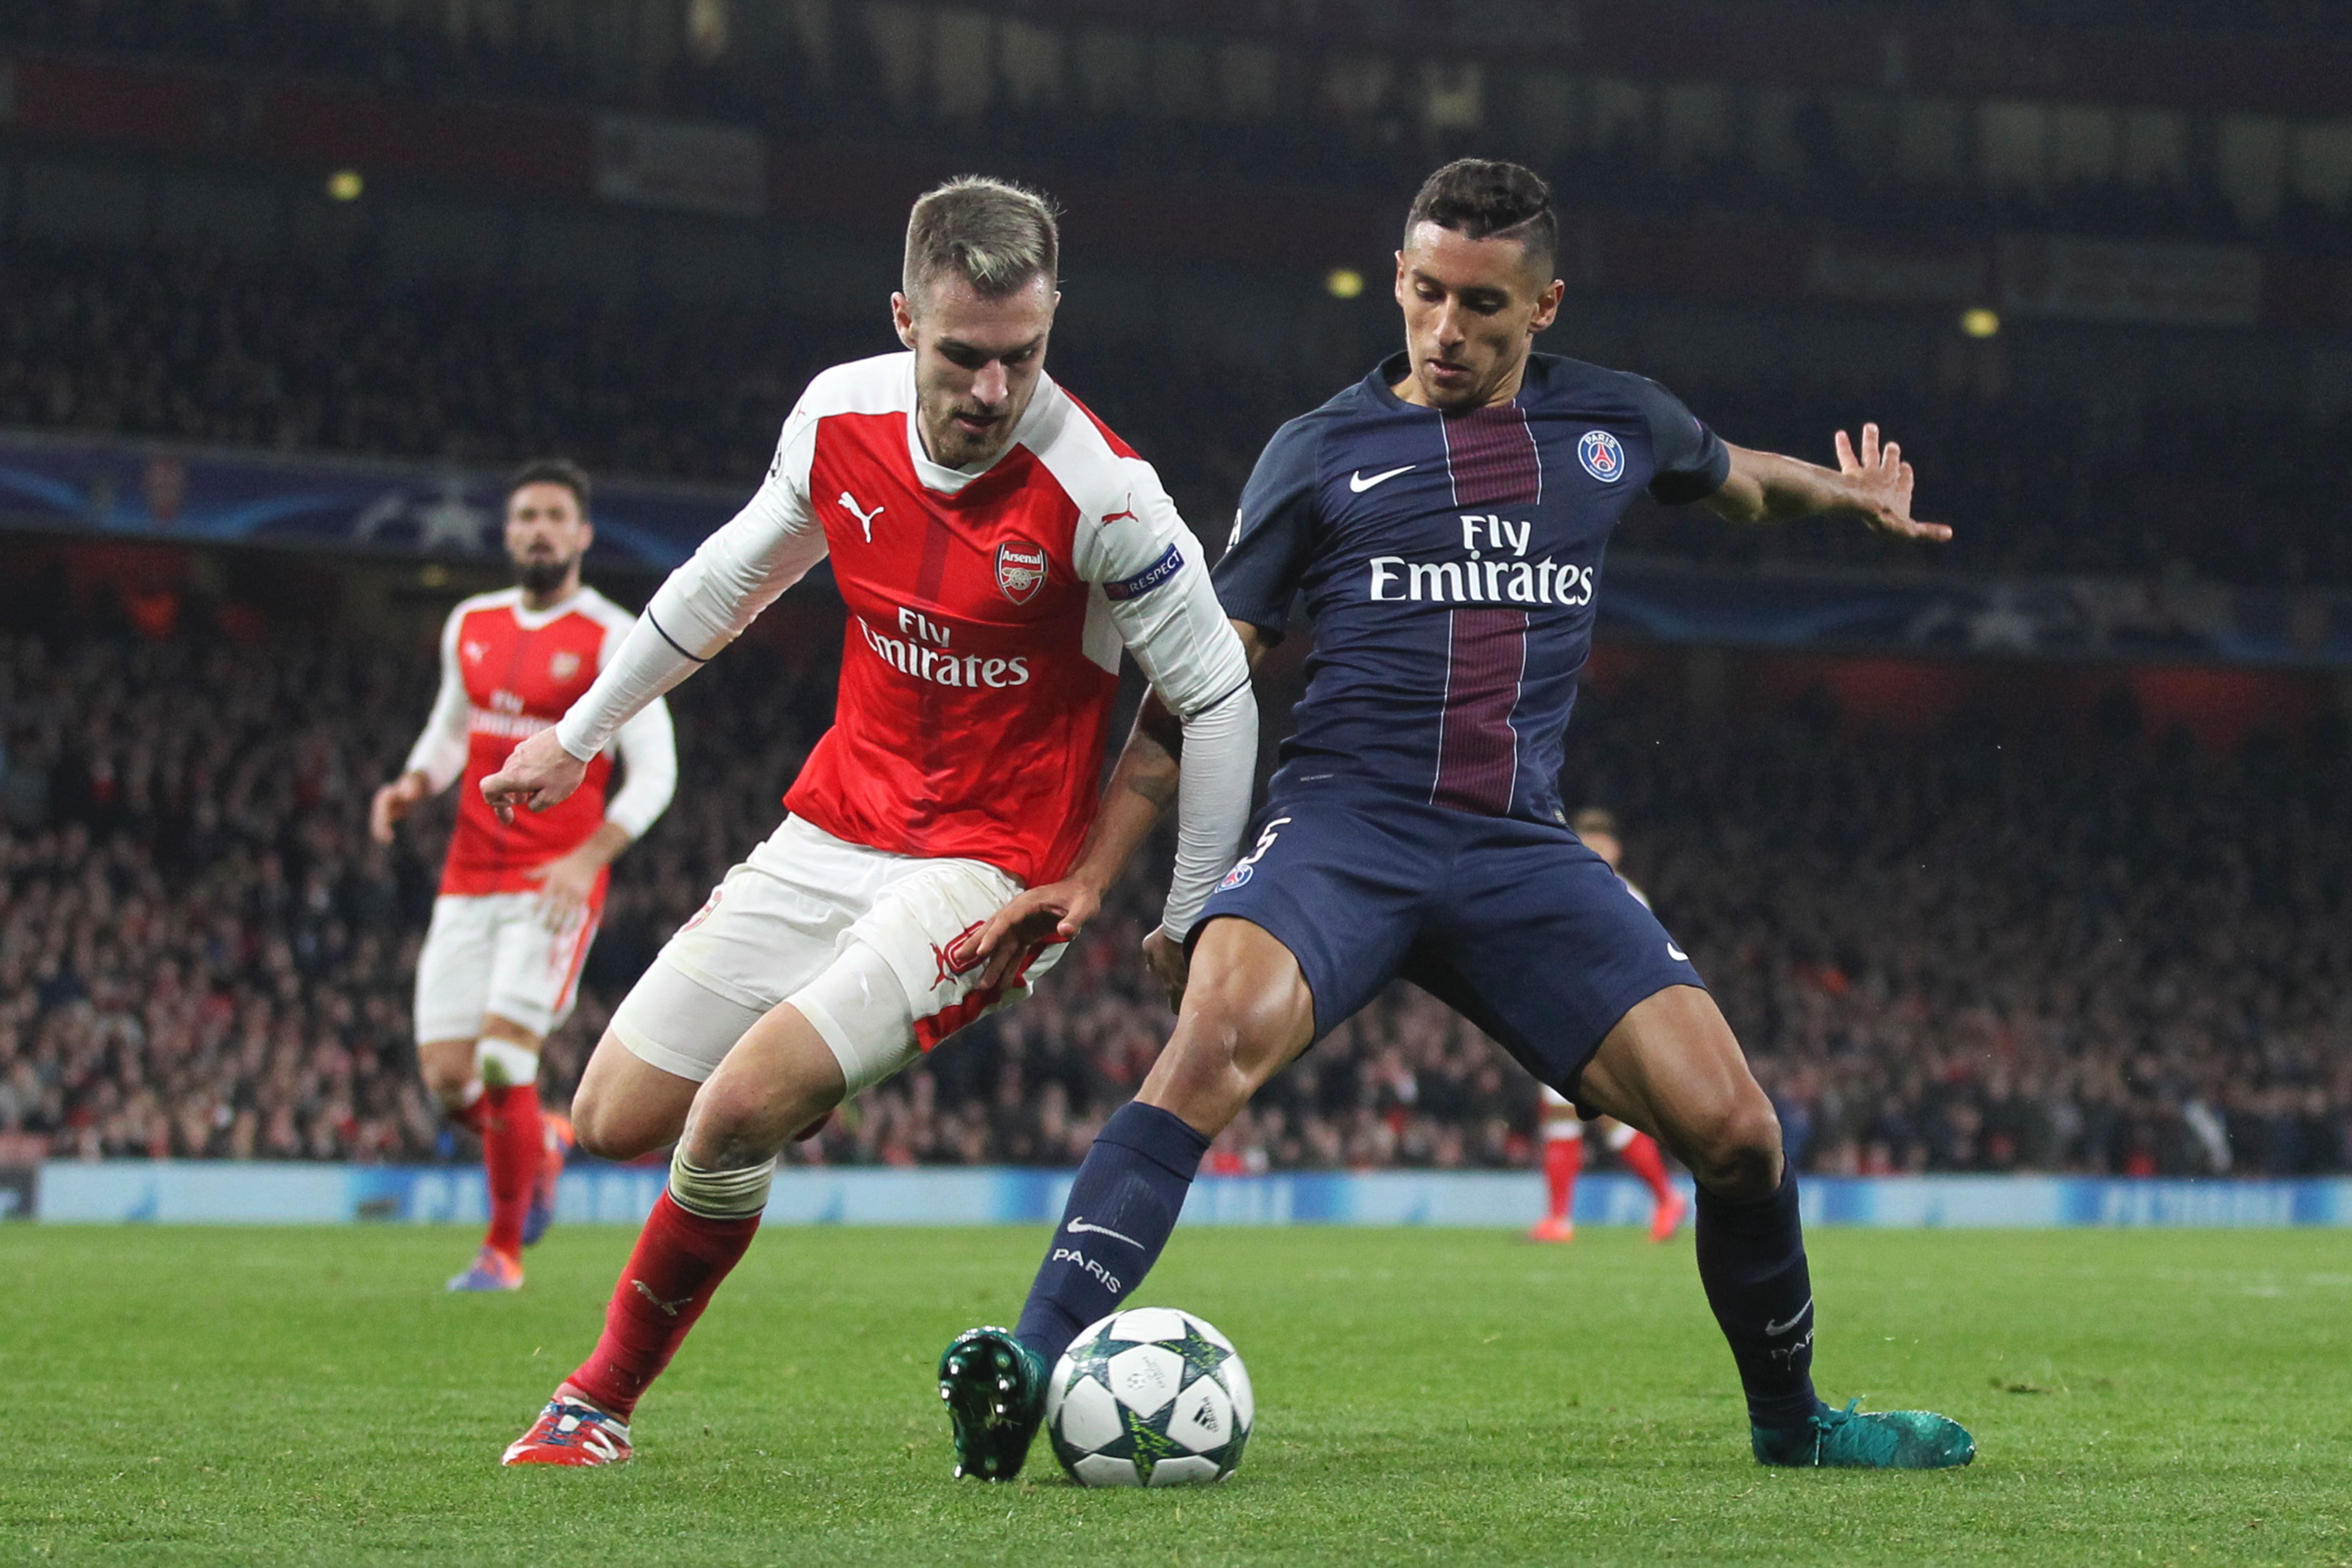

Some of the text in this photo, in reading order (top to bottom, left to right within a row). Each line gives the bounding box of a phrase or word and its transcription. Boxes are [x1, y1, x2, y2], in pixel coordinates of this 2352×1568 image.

[1584, 433, 1616, 448] PARIS
[1460, 514, 1531, 556] Fly
[1002, 550, 1041, 564] Arsenal
[1129, 550, 1180, 592] RESPECT
[1369, 550, 1594, 607] Emirates
[898, 606, 950, 648] Fly
[1052, 1248, 1121, 1293] PARIS
